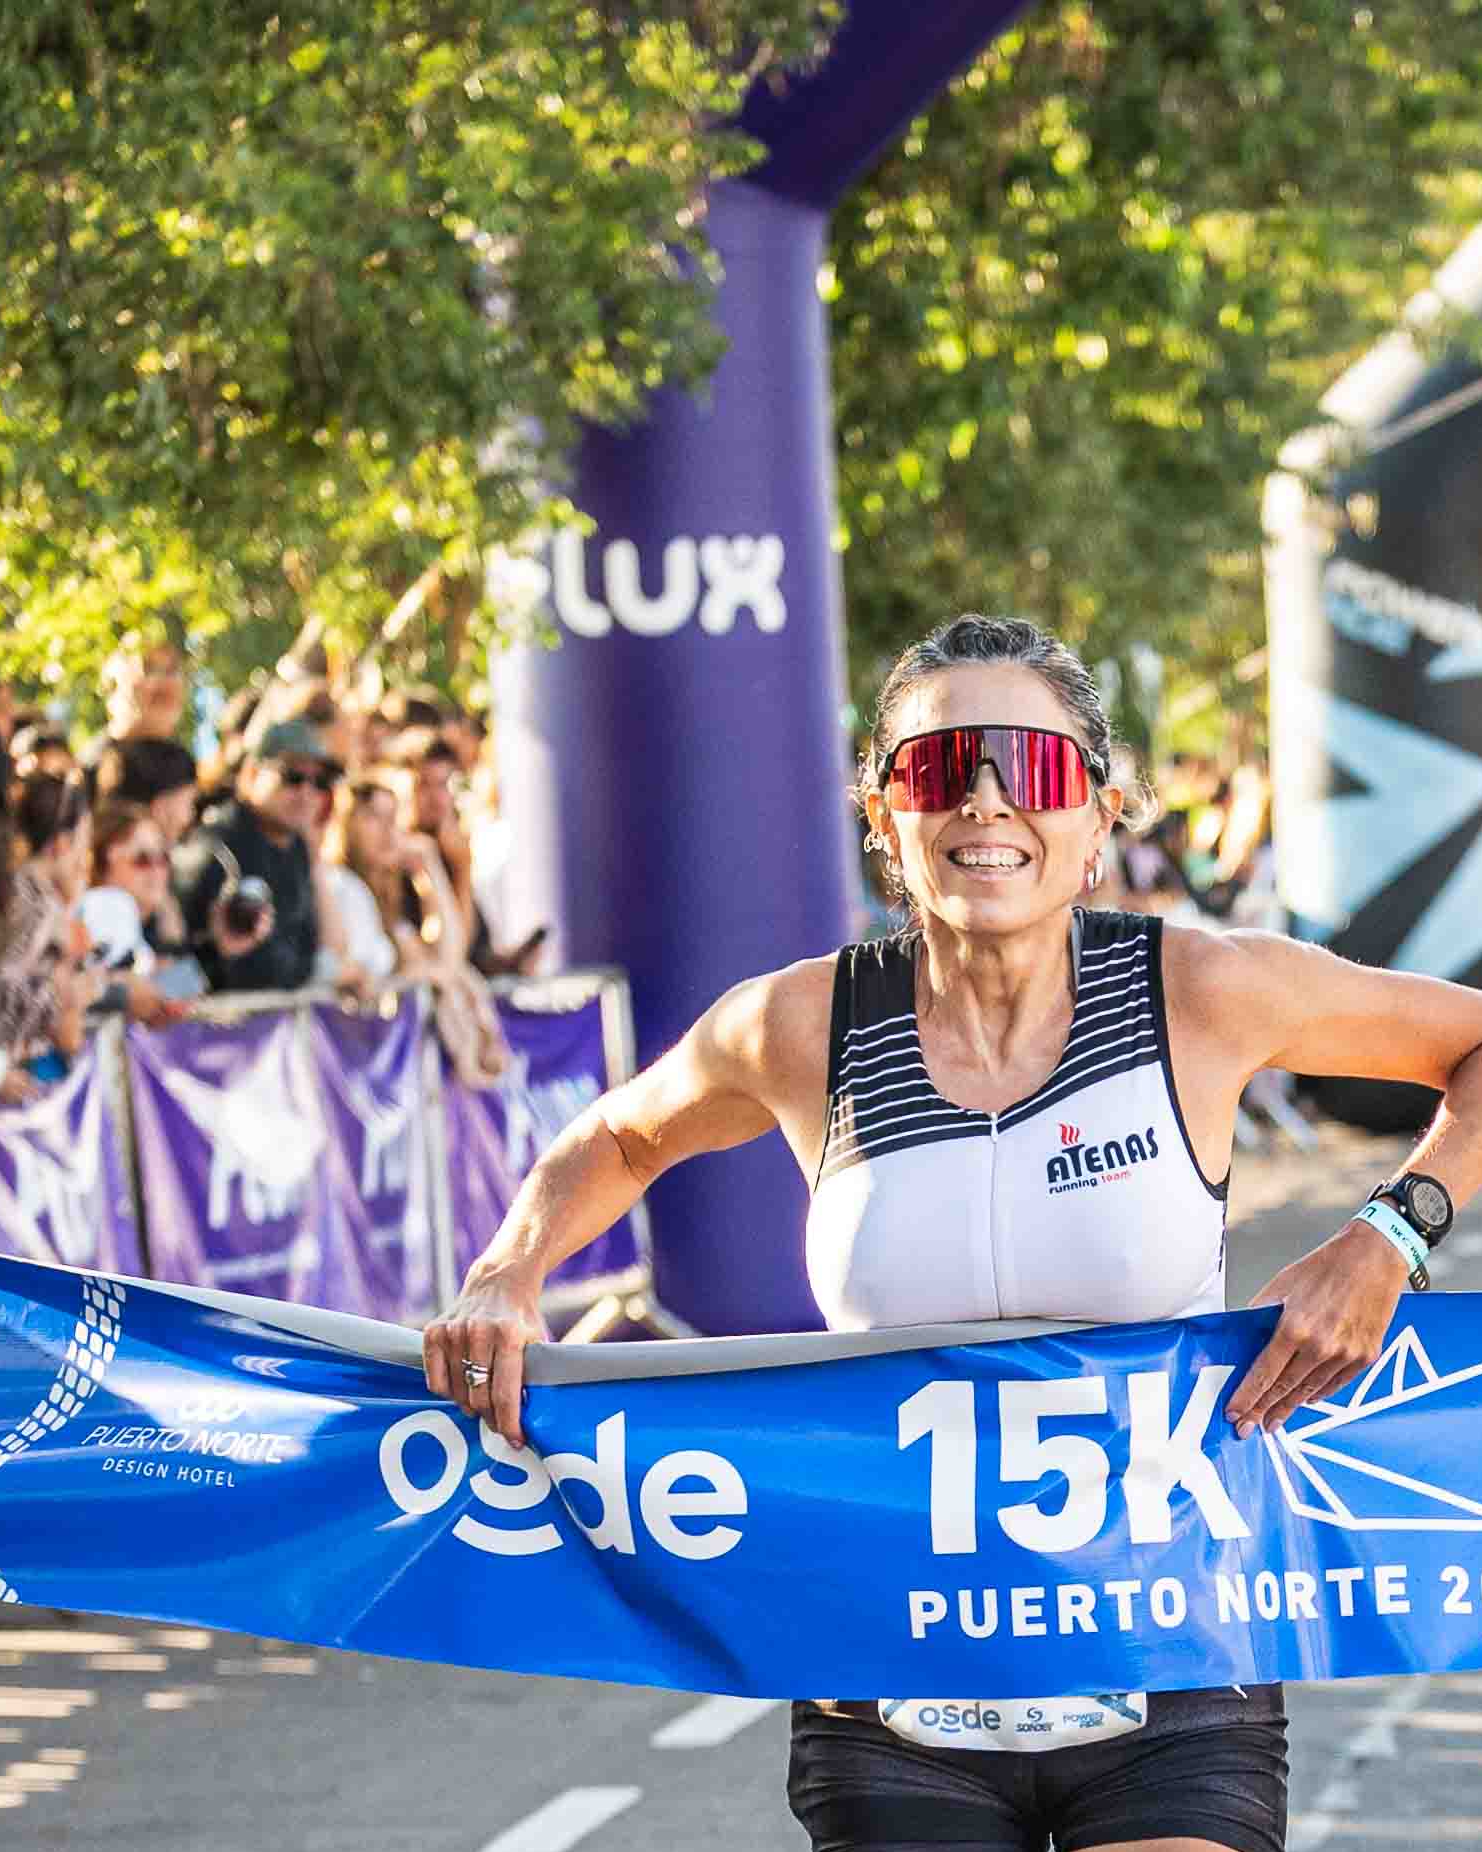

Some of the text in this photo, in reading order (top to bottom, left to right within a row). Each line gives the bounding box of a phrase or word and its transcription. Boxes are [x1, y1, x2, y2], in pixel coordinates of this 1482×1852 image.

[552, 530, 787, 638] LUX
[1046, 1126, 1159, 1184] ATENAS
[1049, 1176, 1098, 1195] running
[81, 1424, 294, 1465] PUERTO NORTE
[101, 1457, 237, 1489] DESIGN HOTEL
[897, 1364, 1252, 1556] 15K
[378, 1408, 749, 1561] osde
[908, 1576, 1186, 1641] PUERTO
[1216, 1564, 1411, 1624] NORTE
[918, 1701, 1001, 1731] osde
